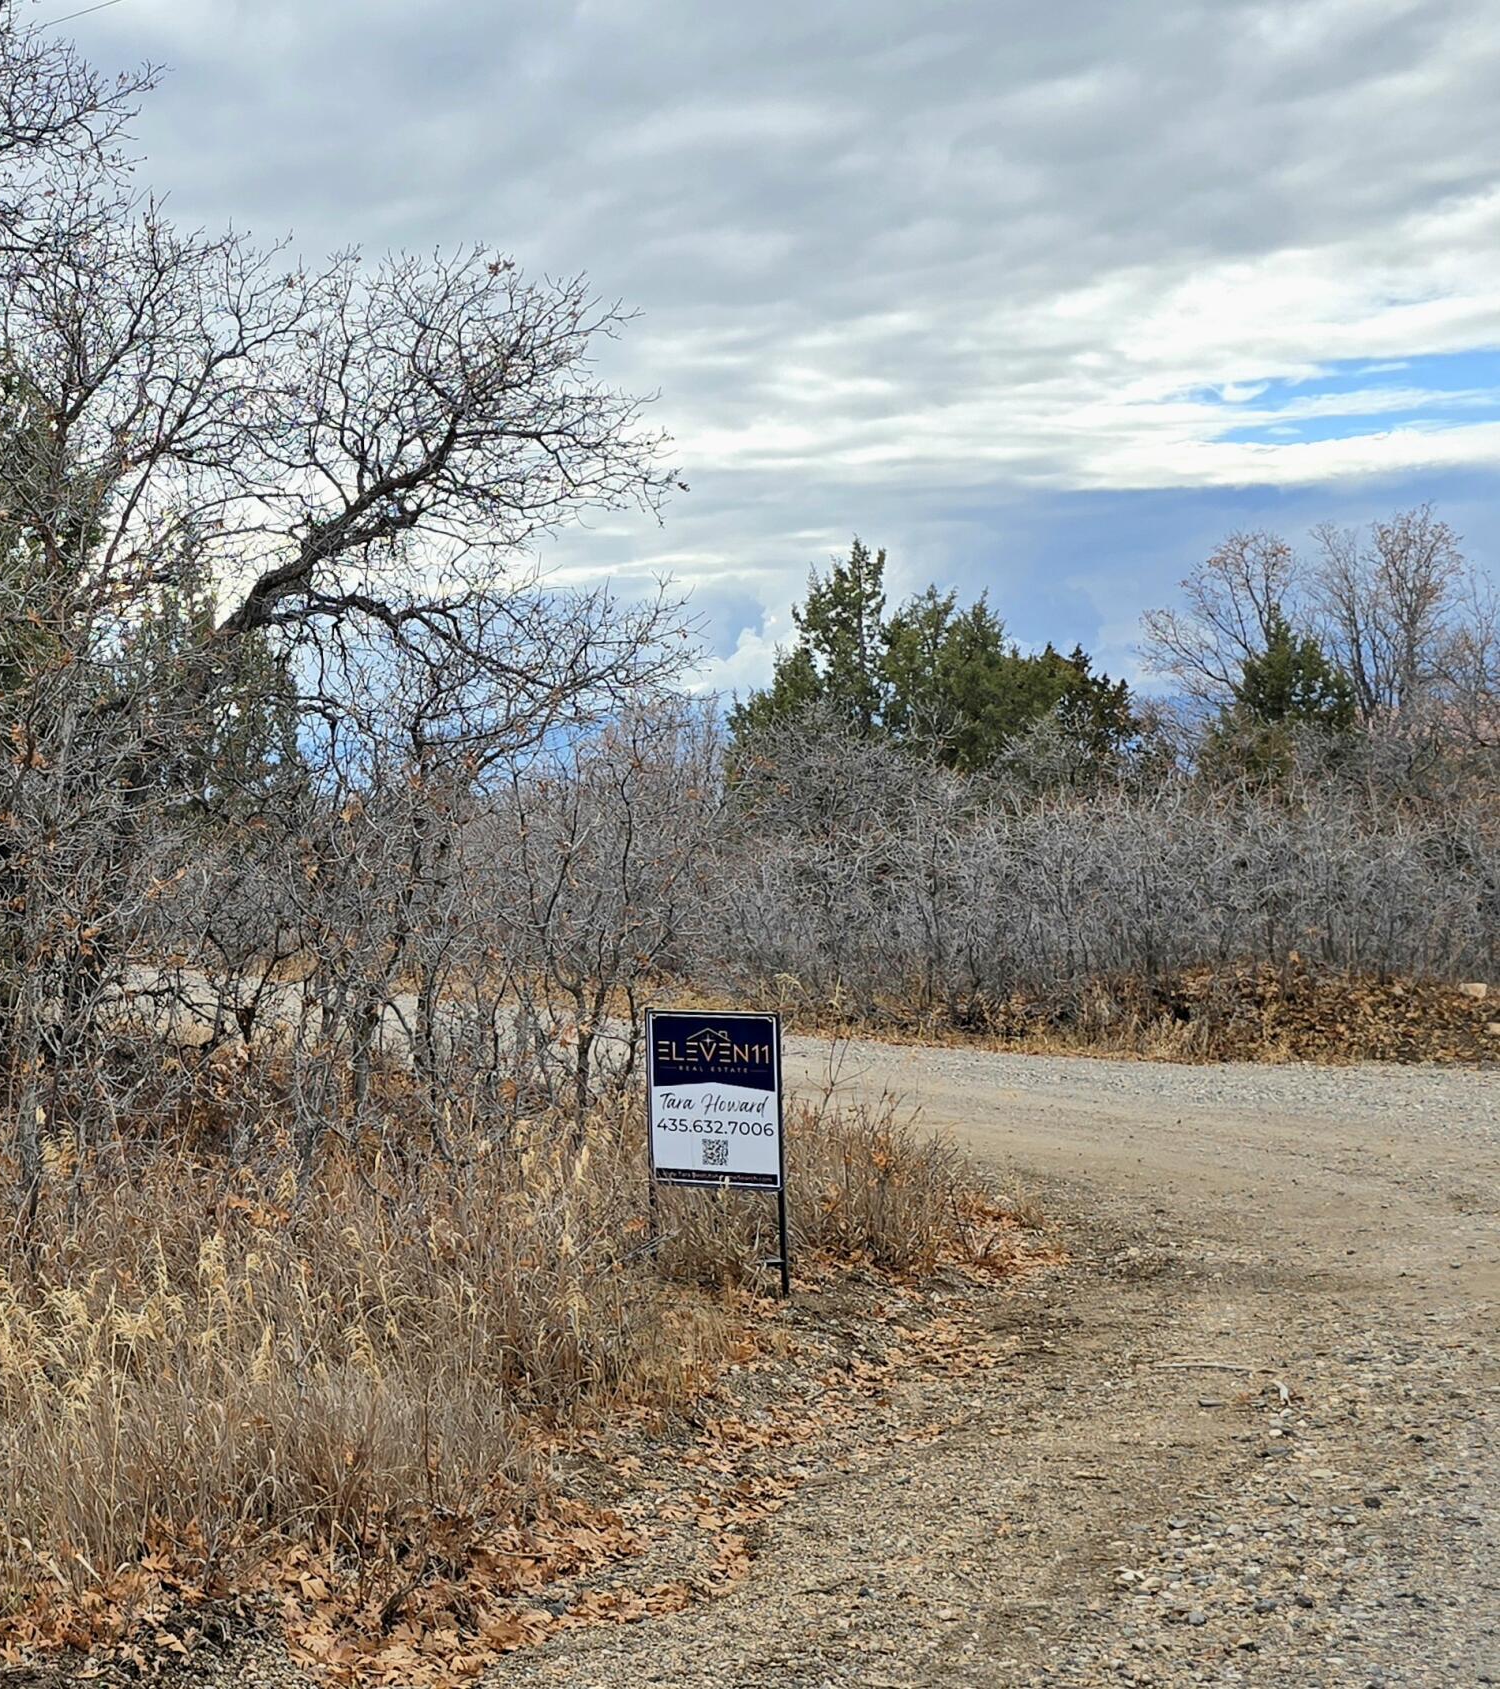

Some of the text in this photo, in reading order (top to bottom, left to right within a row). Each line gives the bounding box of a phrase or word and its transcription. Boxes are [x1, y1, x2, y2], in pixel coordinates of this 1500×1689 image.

[657, 1040, 769, 1064] ELEVEN11
[678, 1065, 749, 1074] REAL ESTATE
[660, 1092, 770, 1118] Tara Howard
[656, 1117, 775, 1137] 435.632.7006
